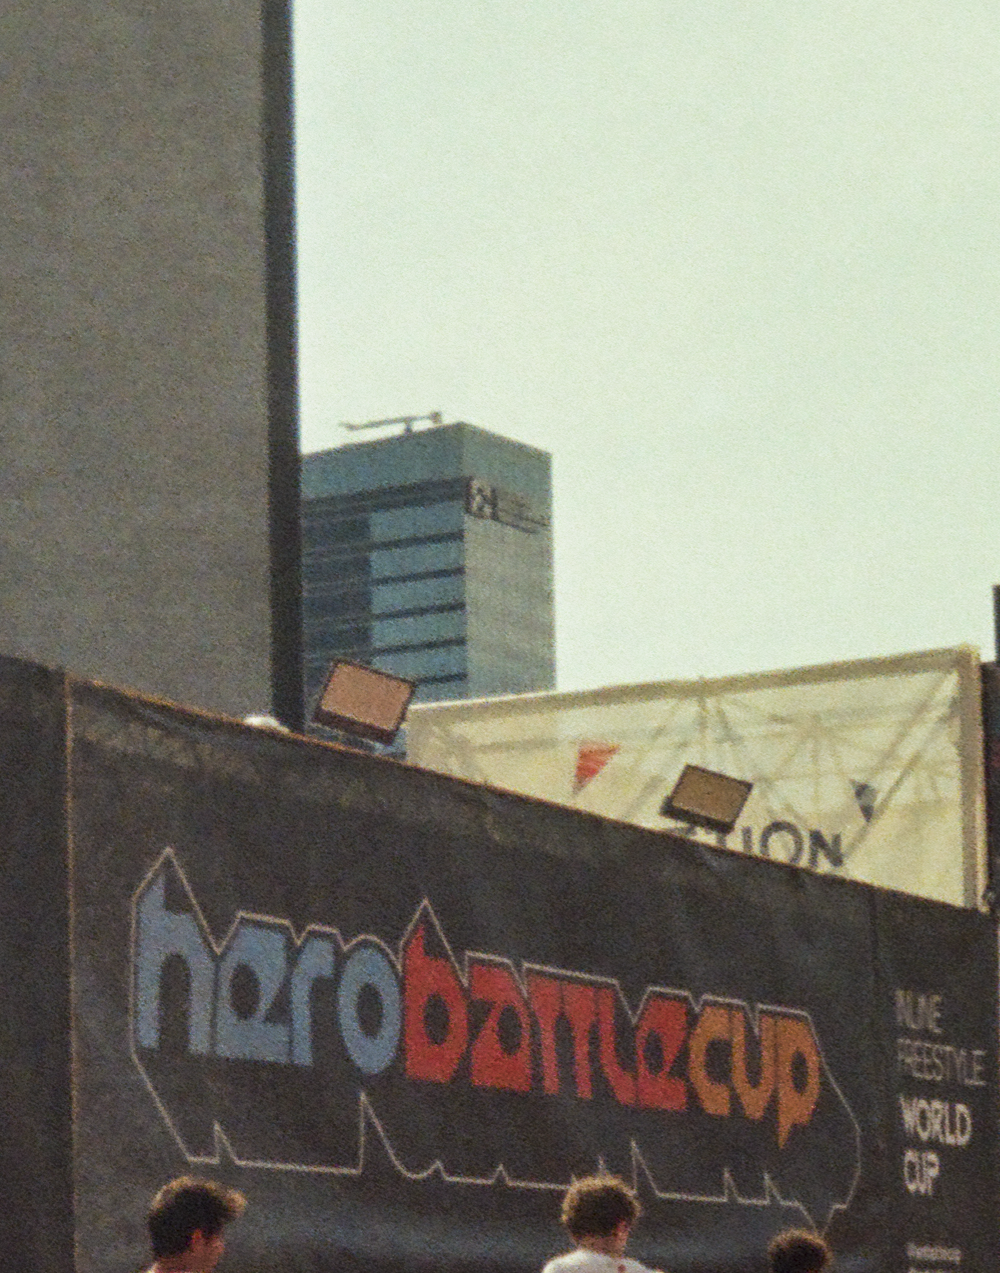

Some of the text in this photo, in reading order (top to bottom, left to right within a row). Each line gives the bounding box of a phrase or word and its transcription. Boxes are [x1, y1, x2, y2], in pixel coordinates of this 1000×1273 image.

[897, 1037, 987, 1087] FREESTYLE
[899, 1094, 973, 1147] WORLD
[903, 1149, 941, 1196] CUP
